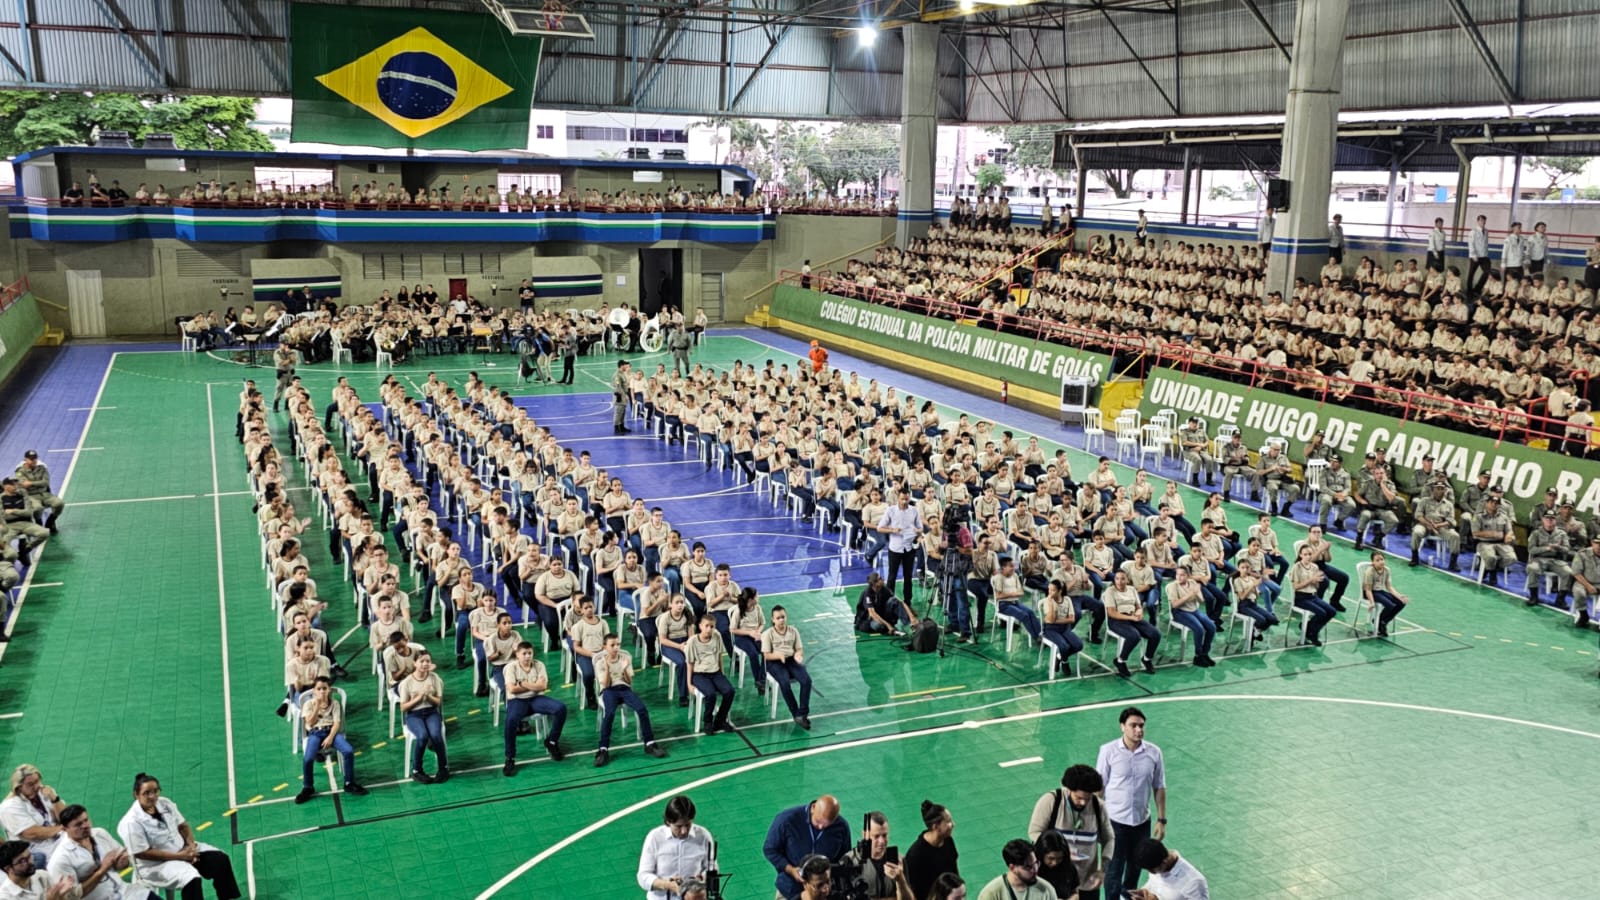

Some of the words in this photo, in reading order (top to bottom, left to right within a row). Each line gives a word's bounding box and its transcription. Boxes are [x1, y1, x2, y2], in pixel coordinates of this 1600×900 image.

[820, 300, 858, 326] COLÉGIO
[858, 309, 905, 339] ESTADUAL
[907, 321, 923, 343] DA
[924, 325, 970, 355] POLÍCIA
[972, 336, 1029, 370] MILITAR
[1029, 349, 1051, 375] DE
[1150, 377, 1244, 423] UNIDADE
[1245, 399, 1318, 442] HUGO
[1322, 417, 1363, 454] DE
[1365, 427, 1543, 498] CARVALHO
